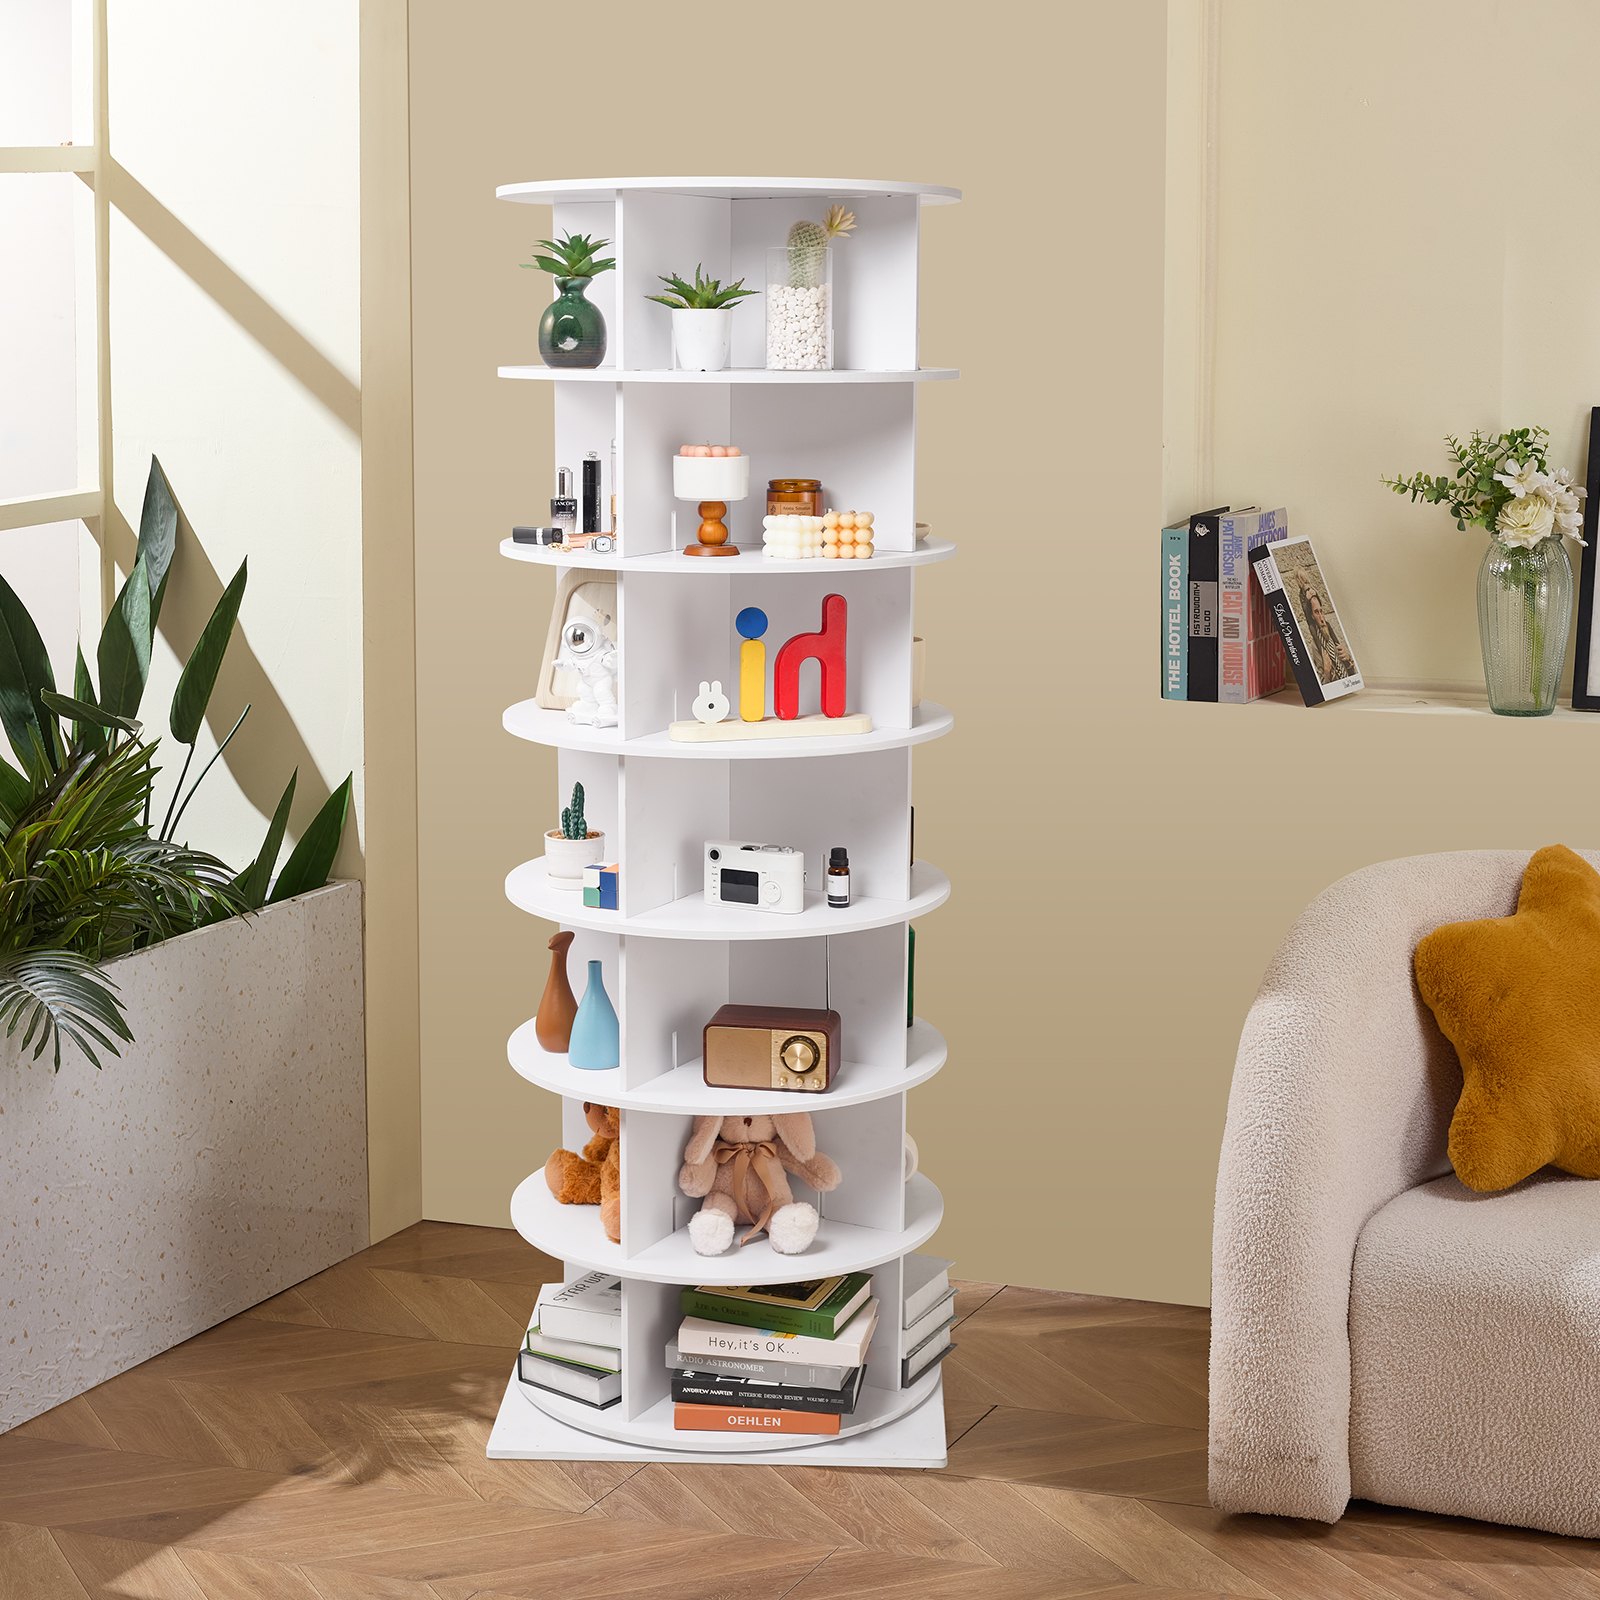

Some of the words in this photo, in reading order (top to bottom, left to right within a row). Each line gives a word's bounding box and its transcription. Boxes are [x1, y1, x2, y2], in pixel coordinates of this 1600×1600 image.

[1258, 511, 1276, 532] JAMES
[1222, 519, 1234, 576] PATTERSON
[1234, 536, 1243, 559] JAMES
[1168, 553, 1181, 601] BOOK
[1257, 562, 1270, 592] COMMUTE
[1261, 559, 1276, 590] COVERING
[1222, 591, 1242, 615] CAT
[1168, 604, 1181, 656] HOTEL
[1222, 616, 1239, 639] AND
[1222, 641, 1243, 686] MOUSE
[1168, 659, 1181, 693] THE
[553, 1283, 590, 1302] STAR
[676, 1354, 704, 1365] RADIO
[706, 1359, 765, 1373] ASTRONOMER
[738, 1391, 762, 1399] INTERIOR
[763, 1392, 783, 1400] DESIGN
[727, 1415, 782, 1427] OEHLEN
